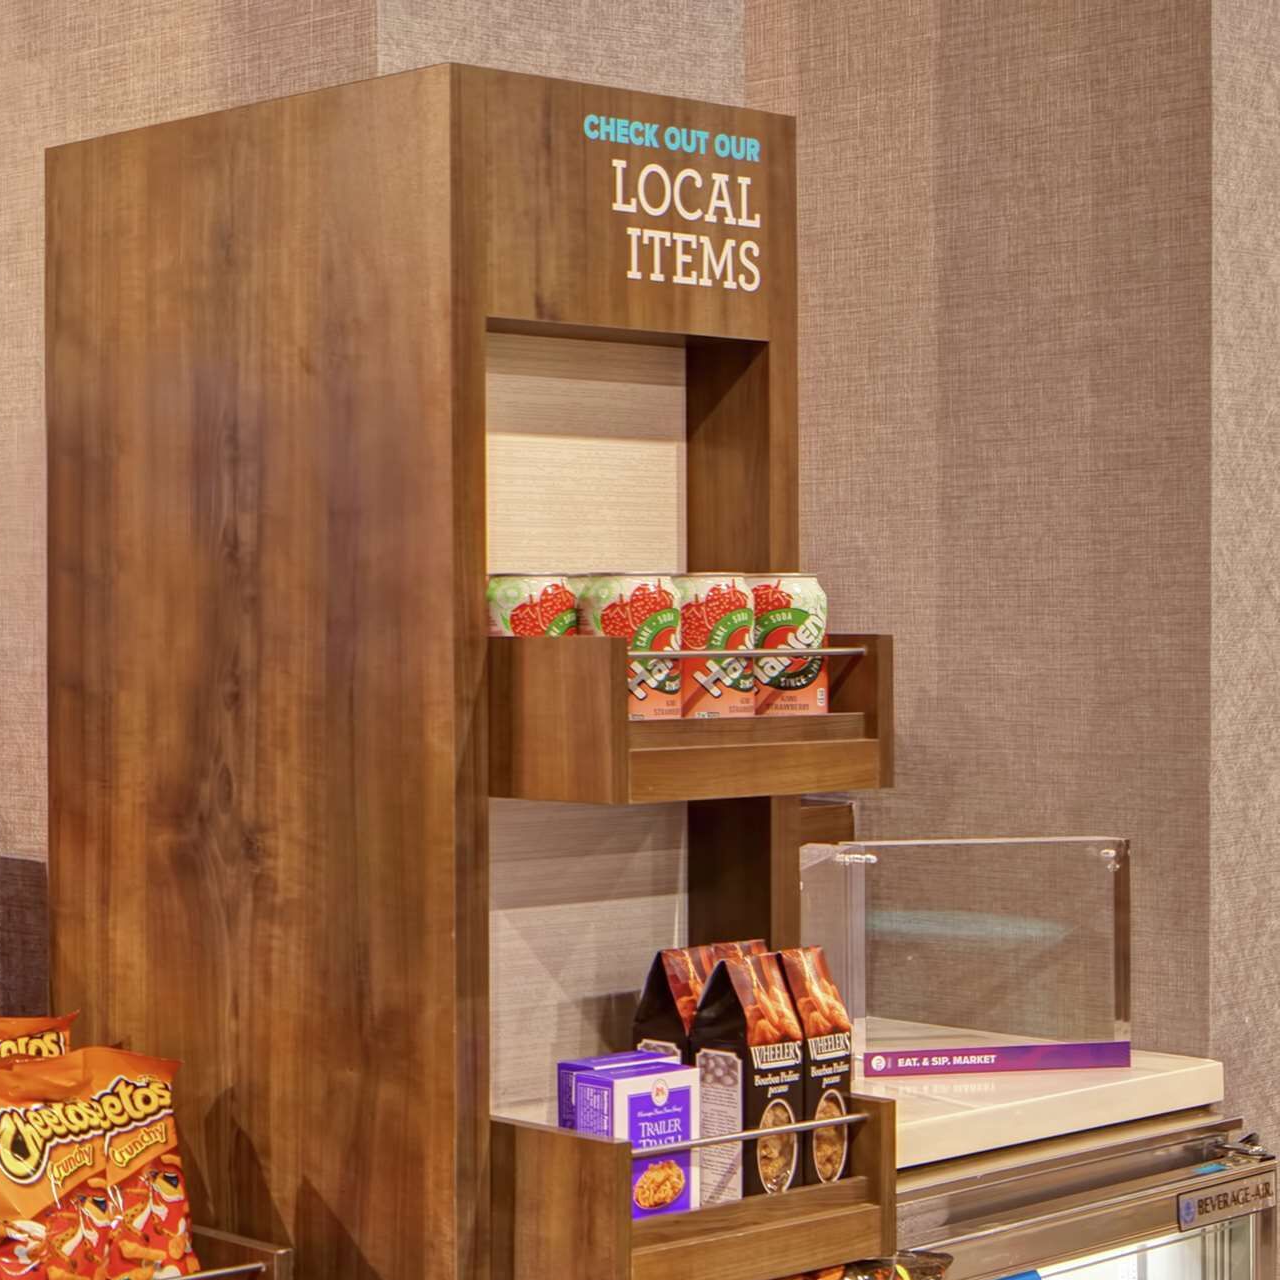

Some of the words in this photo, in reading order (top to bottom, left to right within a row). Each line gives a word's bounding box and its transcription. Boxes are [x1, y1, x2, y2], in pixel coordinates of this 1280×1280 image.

[584, 114, 659, 148] CHECK
[664, 126, 709, 155] OUT
[714, 134, 760, 162] OUR
[612, 158, 761, 228] LOCAL
[626, 226, 761, 292] ITEMS
[770, 611, 792, 625] SODA
[750, 1039, 802, 1069] WHEELER'S
[806, 1030, 851, 1061] WHEELER'S
[897, 1058, 920, 1067] EAT.
[931, 1056, 951, 1066] SIP.
[952, 1054, 997, 1065] MARKET
[638, 1117, 682, 1139] TRAILER
[110, 1122, 166, 1168] Crunchy
